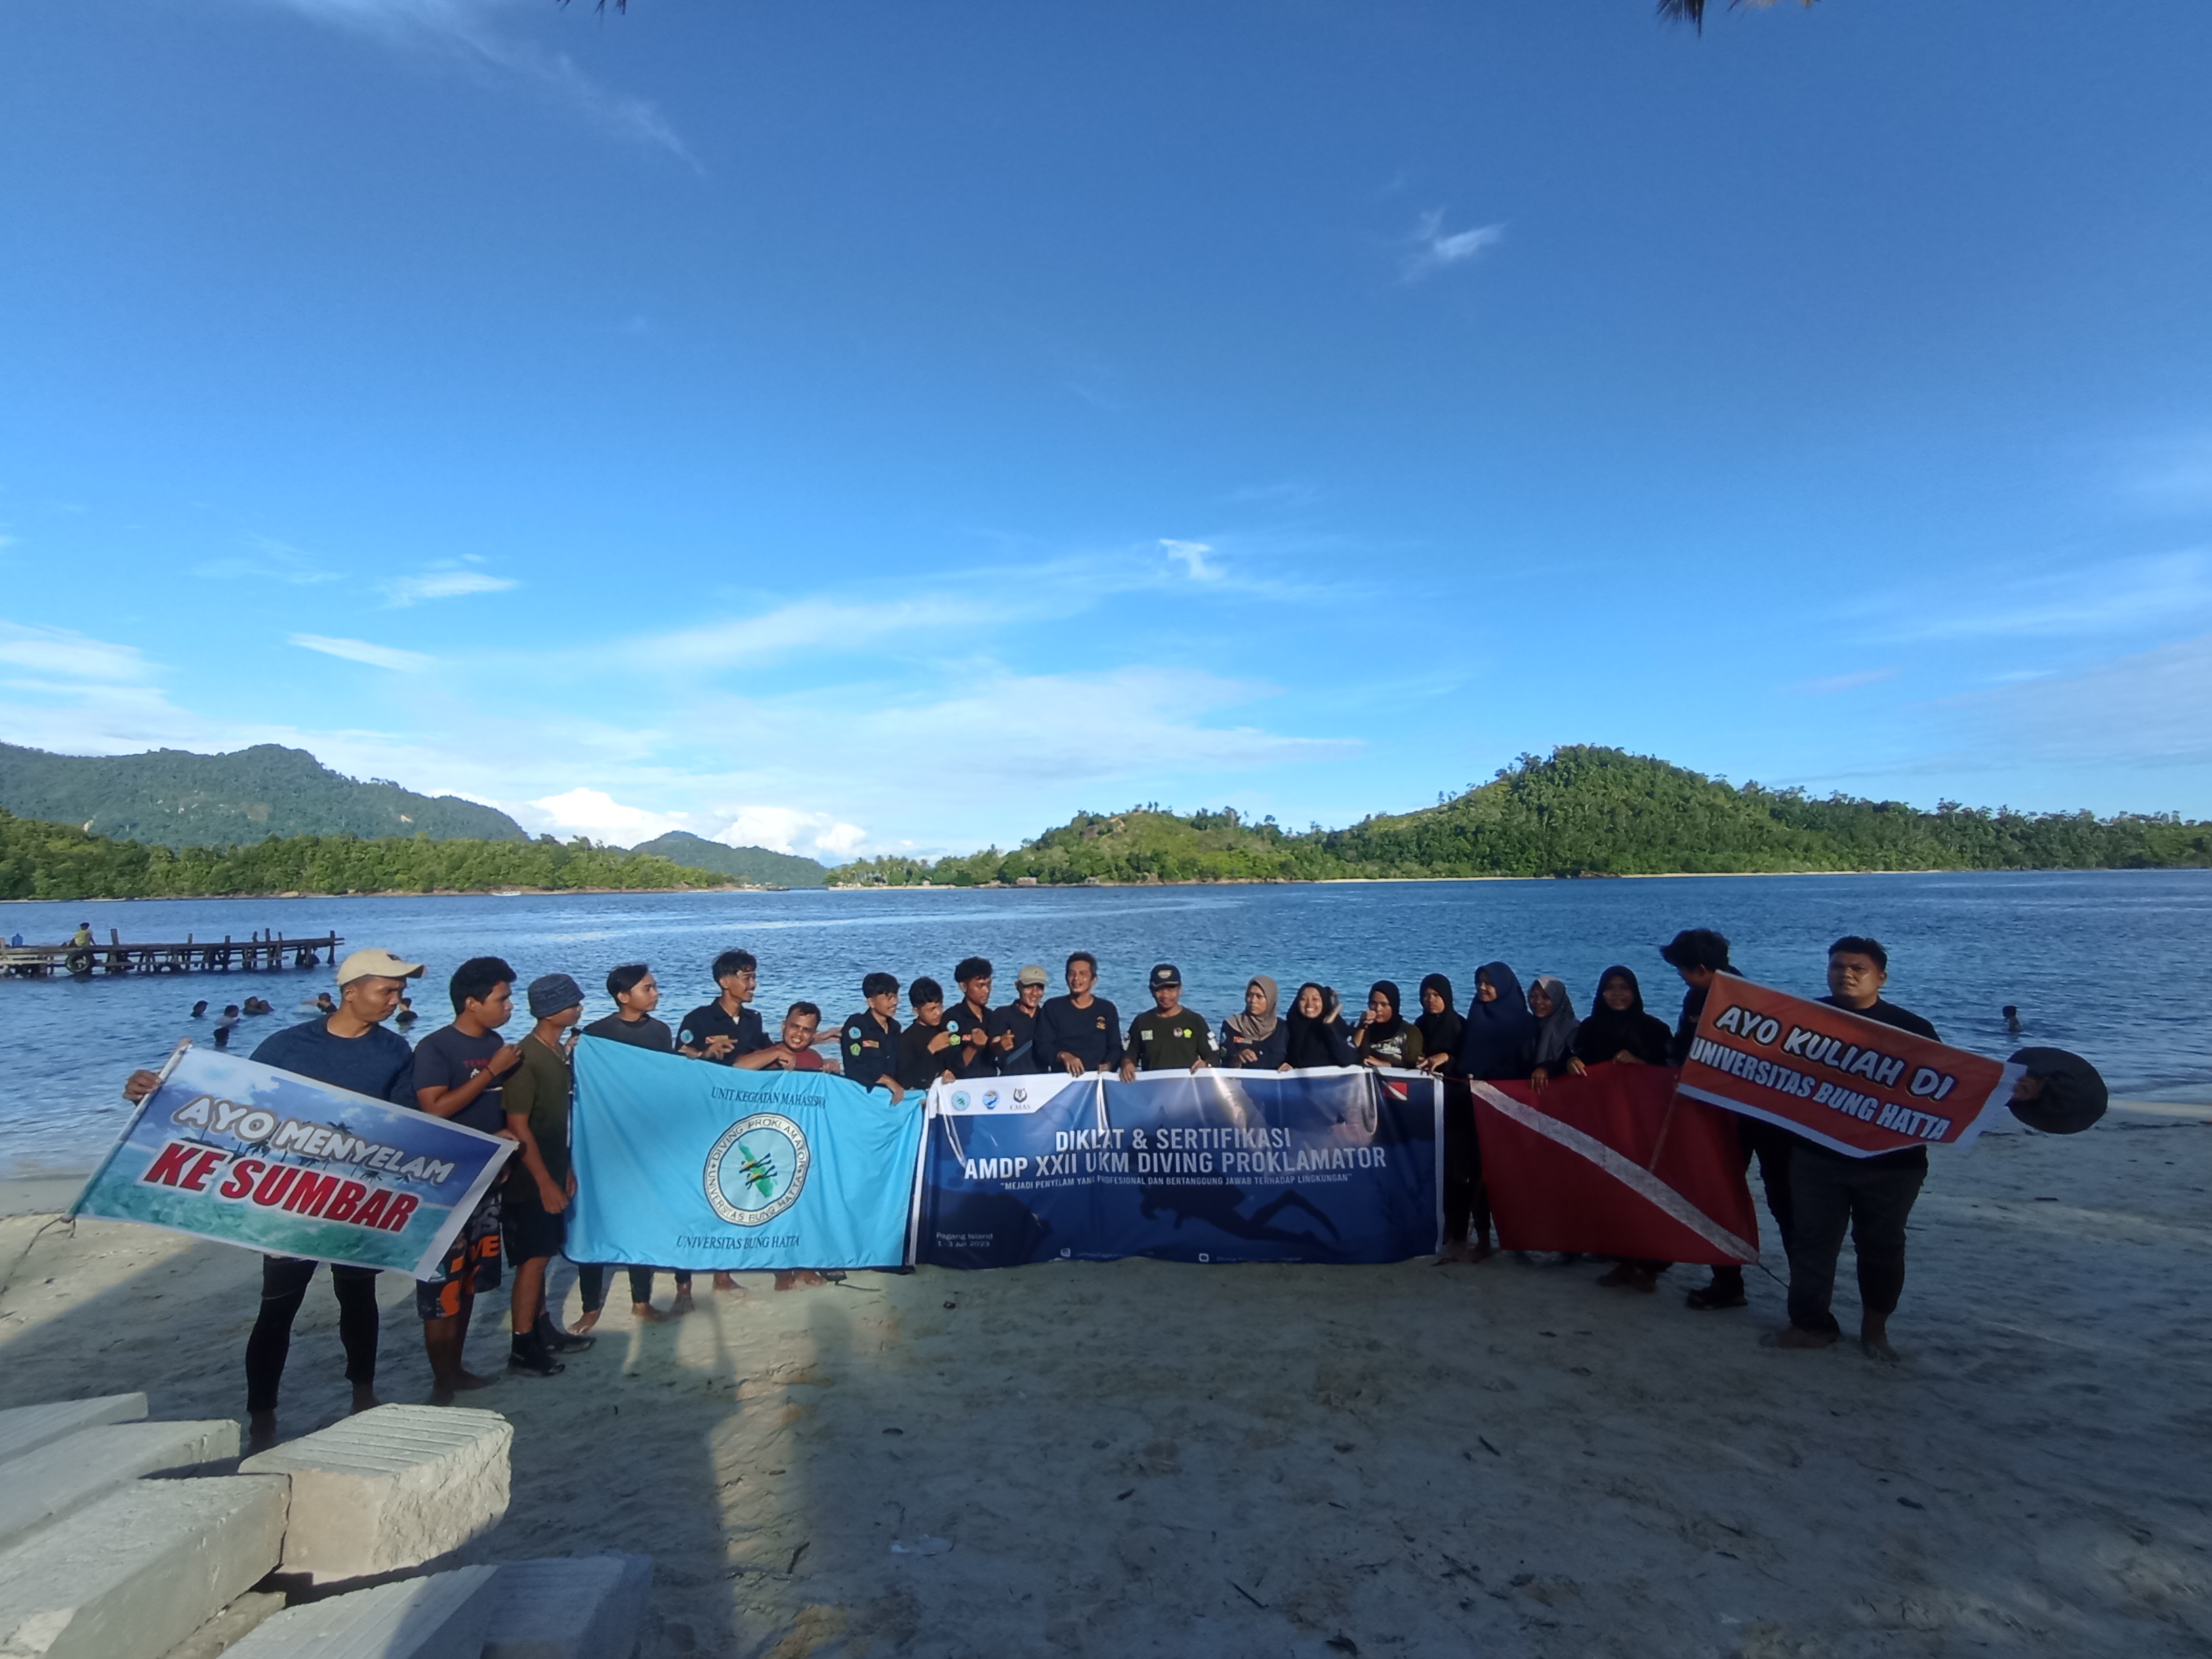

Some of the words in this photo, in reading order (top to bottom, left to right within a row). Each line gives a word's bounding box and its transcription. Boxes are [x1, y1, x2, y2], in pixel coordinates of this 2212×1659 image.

[1715, 1006, 1780, 1044] AYO
[1784, 1027, 1903, 1087] KULIAH
[1910, 1068, 1955, 1101] DI
[712, 1086, 735, 1101] UNIT
[735, 1090, 780, 1104] KEGIATAN
[1689, 1038, 1815, 1098] UNIVERSITAS
[1813, 1082, 1877, 1121] BUNG
[1877, 1103, 1952, 1141] HATTA
[175, 1097, 274, 1141] AYO
[278, 1122, 455, 1186] MENYELAM
[712, 1126, 743, 1162] DIVING
[747, 1118, 806, 1167] PROKLAMATOR
[1055, 1128, 1126, 1152] DIKLAT
[1132, 1128, 1148, 1150] &
[1156, 1127, 1292, 1150] SERTIFIKASI
[964, 1156, 1029, 1181] AMDP
[1036, 1153, 1078, 1177] XXII
[1086, 1151, 1130, 1174] UKM
[1138, 1151, 1213, 1173] DIVING
[1222, 1146, 1387, 1173] PROKLAMATOR
[1036, 1177, 1075, 1189] PENYELAM
[1077, 1176, 1095, 1185] YANG
[1097, 1174, 1147, 1185] PROFESIONAL
[1148, 1176, 1165, 1185] DAN
[1166, 1176, 1223, 1186] BERTANGGUNG
[1225, 1176, 1252, 1185] JAWAB
[1254, 1176, 1296, 1185] TERHADAP
[143, 1142, 228, 1192] KE
[220, 1158, 420, 1233] SUMBAR
[708, 1170, 745, 1221] UNIVERSITAS
[748, 1206, 776, 1223] BUNG
[777, 1175, 802, 1208] HATTA
[676, 1235, 743, 1249] UNIVERSITAS
[744, 1236, 770, 1250] BUNG
[771, 1235, 800, 1248] HATTA
[936, 1232, 966, 1241] Pagang
